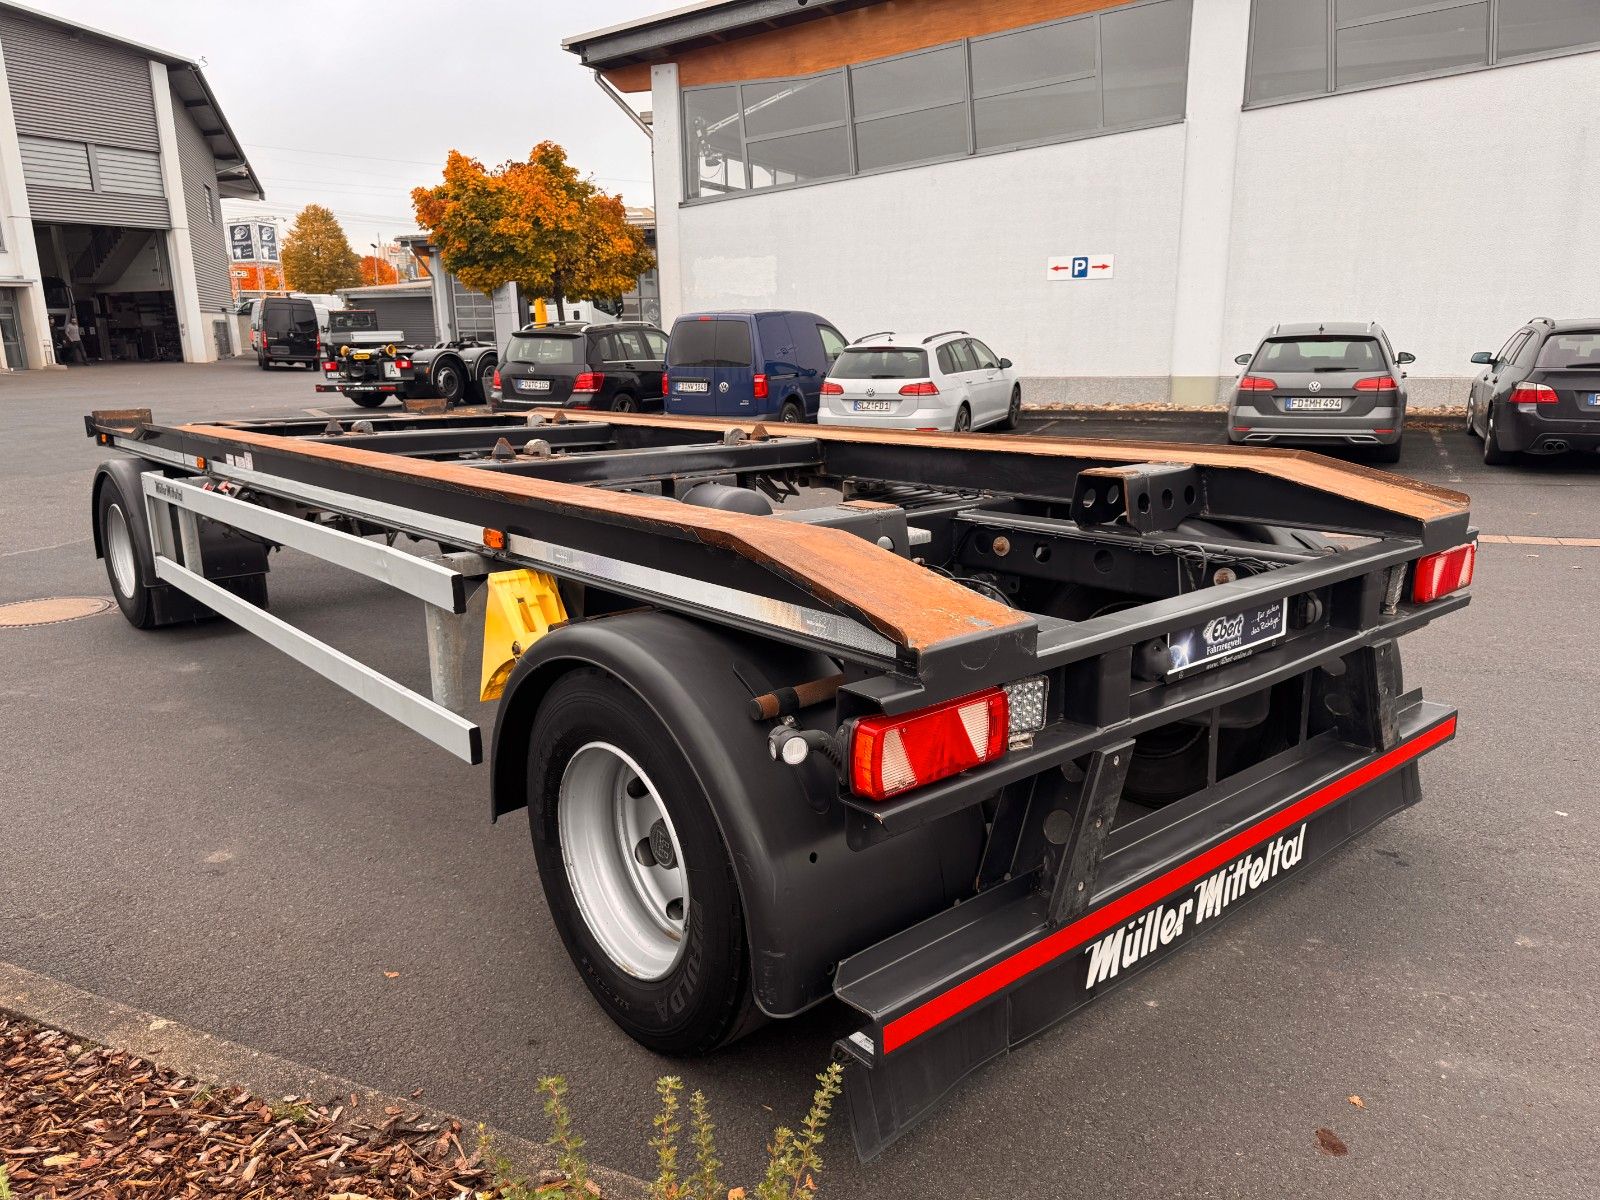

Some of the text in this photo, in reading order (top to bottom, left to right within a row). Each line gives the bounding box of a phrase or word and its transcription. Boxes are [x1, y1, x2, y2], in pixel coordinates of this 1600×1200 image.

[1073, 259, 1087, 276] P
[389, 364, 396, 375] A
[1323, 399, 1341, 408] 494
[1212, 618, 1243, 642] Ebert
[1085, 822, 1307, 990] Müller Mitteltal
